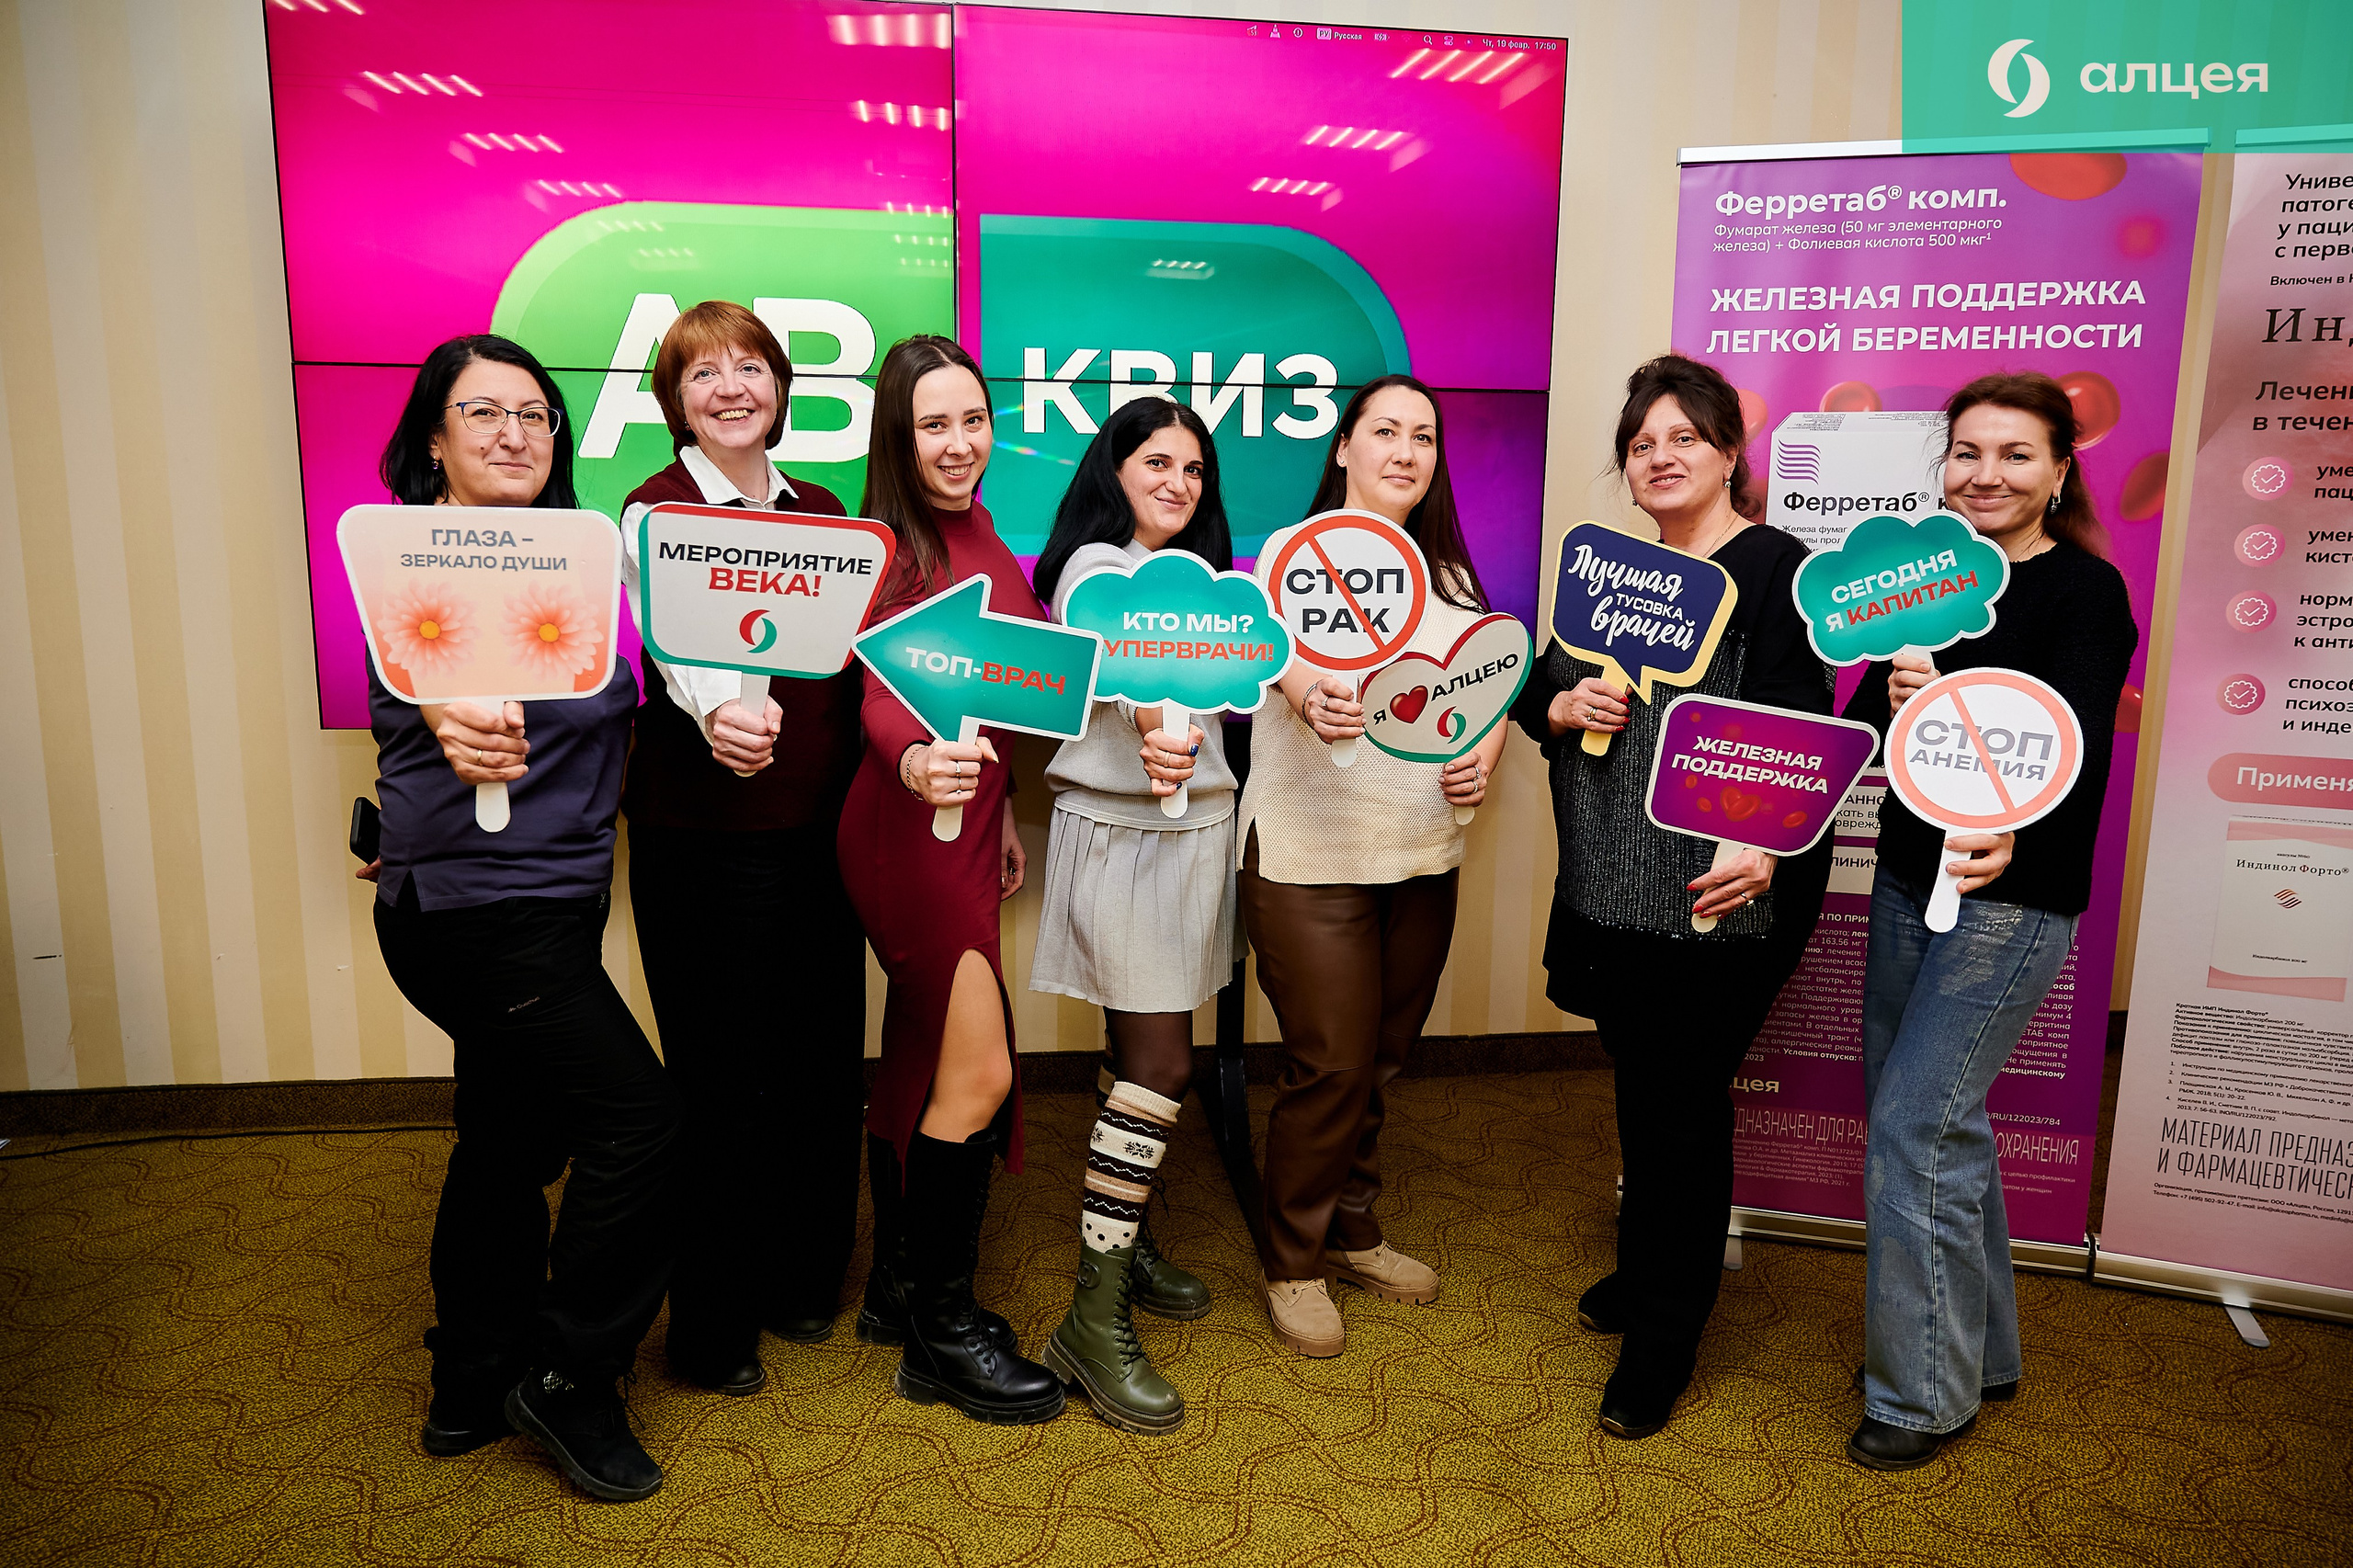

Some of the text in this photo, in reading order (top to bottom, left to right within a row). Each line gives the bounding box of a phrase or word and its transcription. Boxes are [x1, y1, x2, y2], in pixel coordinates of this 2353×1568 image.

[1334, 31, 1362, 40] Русская
[1496, 40, 1506, 48] 19
[2285, 173, 2353, 190] Униве
[1908, 187, 2007, 211] комп.
[1714, 217, 2003, 239] Фумарат железа (50 мг элементарного
[2277, 222, 2290, 239] у
[1712, 239, 1771, 254] железа)
[1775, 242, 1785, 251] +
[1788, 235, 1862, 252] Фолиевая
[1864, 236, 1925, 249] кислота
[1928, 233, 1955, 247] 500
[2274, 244, 2353, 261] с перв
[2269, 275, 2345, 286] Включен в
[1710, 280, 2146, 312] ЖЕЛЕЗНАЯ ПОДДЕРЖКА
[2261, 308, 2353, 347] Ин
[1706, 323, 2143, 355] ЛЕГКОЙ БЕРЕМЕННОСТИ
[1022, 347, 1339, 441] КВИЗ
[2253, 416, 2268, 431] в
[2315, 465, 2353, 481] уме
[2314, 487, 2353, 501] пац
[431, 528, 517, 548] ГЛАЗА
[1781, 525, 1816, 533] Железа
[400, 553, 567, 572] ЗЕРКАЛО ДУШИ
[658, 540, 872, 576] МЕРОПРИЯТИЕ
[2305, 551, 2353, 563] кист
[709, 567, 823, 597] ВЕКА!
[1286, 568, 1405, 595] СТОП
[1567, 543, 1684, 603] Лучшая
[1831, 549, 1958, 604] СЕГОДНЯ
[1616, 592, 1684, 621] ТУСОВКА
[1824, 570, 1979, 632] Я КАПИТАН
[2300, 594, 2353, 609] норм
[1123, 611, 1255, 633] КТО МЫ?
[1302, 608, 1391, 634] РАК
[1590, 597, 1696, 652] врачей
[2296, 615, 2353, 631] эстро
[1103, 639, 1275, 661] УПЕРВРАЧИ!
[2294, 636, 2306, 647] к
[904, 646, 1066, 696] ТОП-ВРАЧ
[1372, 653, 1519, 726] Я АЛЦЕЮ
[2282, 720, 2352, 734] и инде
[1915, 719, 2054, 761] СТОП
[1692, 735, 1824, 771] ЖЕЛЕЗНАЯ
[1671, 754, 1829, 794] ПОДДЕРЖКА
[1909, 748, 2047, 781] АНЕМИЯ
[2237, 767, 2353, 791] Применя
[2236, 858, 2297, 872] Индинол
[1826, 913, 1842, 922] ПО
[1826, 949, 1861, 957] лечение
[1781, 1003, 1836, 1013] нормального
[1808, 1014, 1839, 1022] железа
[1815, 1024, 1859, 1033] отдельных
[1827, 1034, 1849, 1042] тракт
[1771, 1039, 1833, 1050] аллергические
[2012, 1048, 2058, 1058] ощущения
[1745, 1052, 1765, 1062] 2023
[1783, 1048, 1857, 1062] Условия отпуска:
[2019, 1058, 2066, 1069] применять
[1731, 1076, 1779, 1094] цея
[1734, 1108, 1846, 1145] ДНАЗНАЧЕН ДЛЯ
[2161, 1117, 2353, 1168] МАТЕРИАЛ ПРЕДНАЗ
[2157, 1147, 2170, 1174] И
